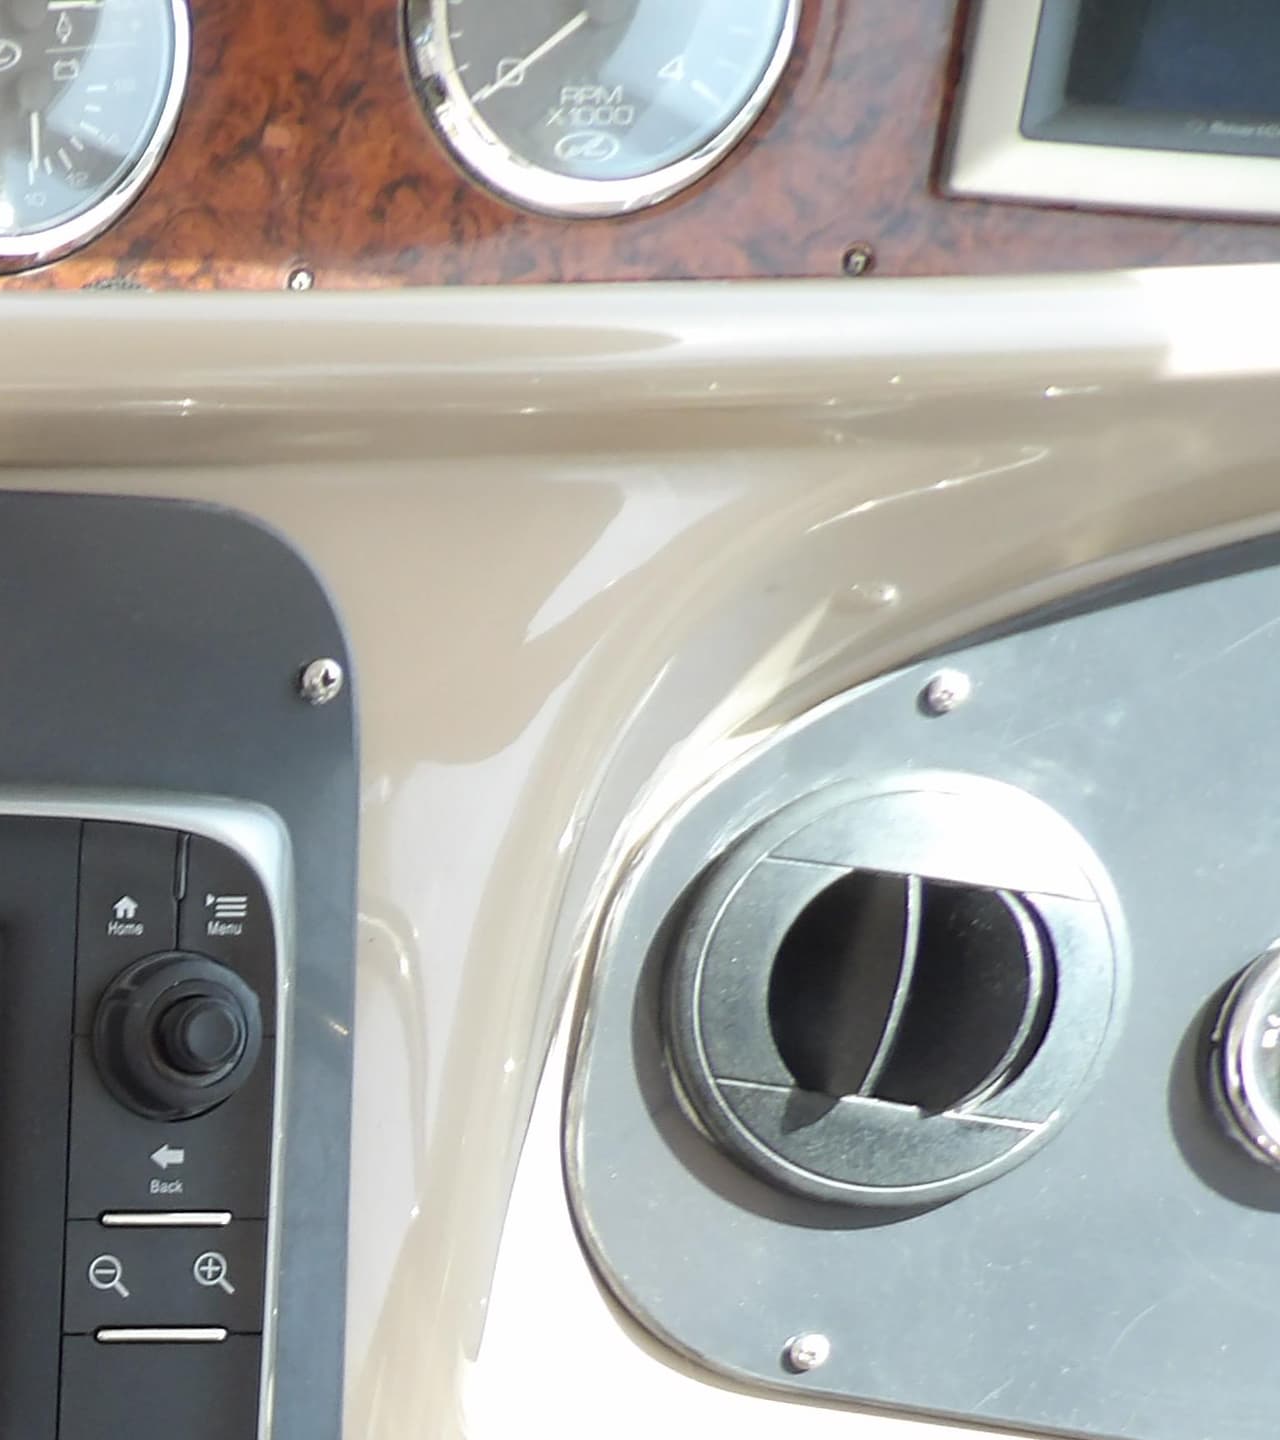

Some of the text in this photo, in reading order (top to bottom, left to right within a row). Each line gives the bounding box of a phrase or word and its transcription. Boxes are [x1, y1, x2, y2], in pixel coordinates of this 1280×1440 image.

[656, 55, 687, 81] 4
[560, 84, 624, 106] RPM
[107, 921, 144, 936] Home
[207, 920, 243, 936] Menu
[149, 1180, 184, 1195] Back
